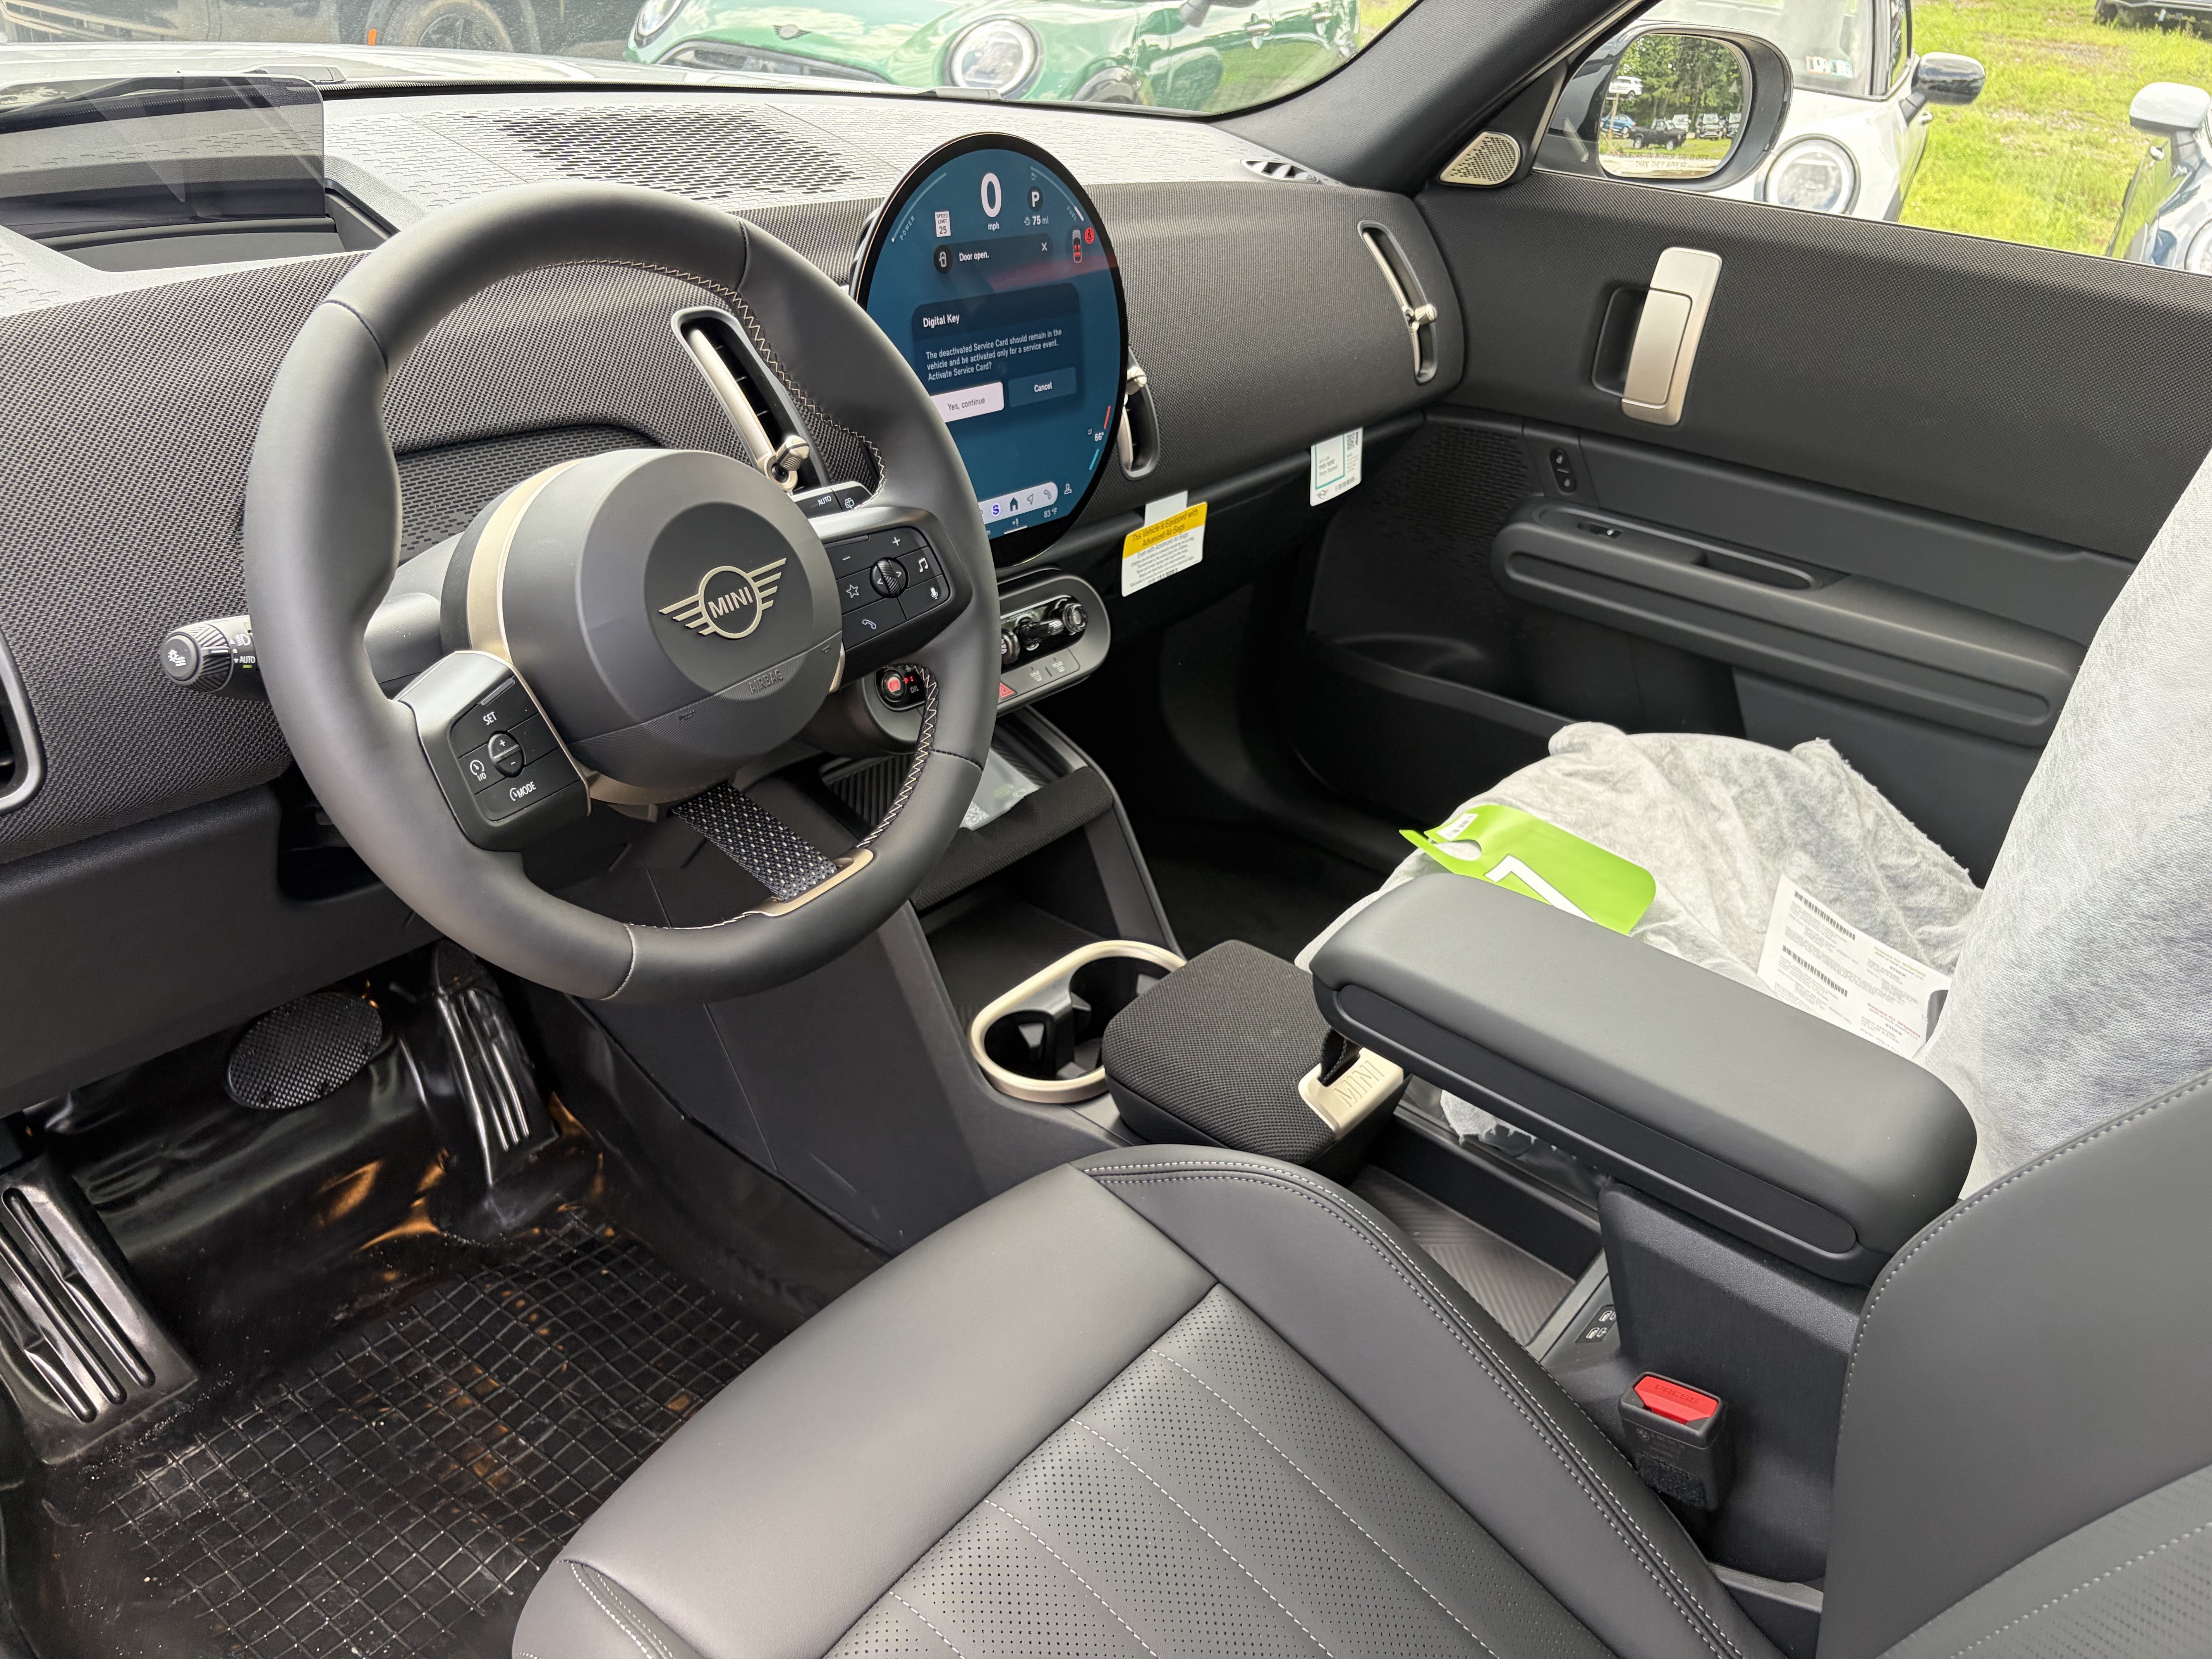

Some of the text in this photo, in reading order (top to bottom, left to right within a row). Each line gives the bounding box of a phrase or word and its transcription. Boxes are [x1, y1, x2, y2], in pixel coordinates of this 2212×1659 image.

[981, 172, 1002, 218] 0
[1031, 191, 1040, 207] P
[1032, 215, 1049, 225] 75 mi
[1066, 206, 1077, 222] FUEL
[900, 216, 915, 240] POWER
[939, 226, 947, 235] 25
[988, 222, 1000, 232] mph
[959, 251, 989, 262] Door open.
[923, 313, 960, 328] Digital Key
[926, 350, 938, 360] The
[939, 343, 972, 357] deactivated
[974, 341, 994, 352] Service
[995, 338, 1008, 348] Card
[1010, 335, 1027, 345] should
[1029, 332, 1046, 341] remain
[927, 360, 948, 371] vehicle
[949, 357, 960, 366] and
[962, 355, 969, 364] be
[970, 350, 996, 362] activated
[997, 348, 1008, 358] only
[1023, 342, 1042, 352] service
[1042, 338, 1059, 349] event.
[928, 362, 992, 381] Activate Service Card?
[1034, 381, 1053, 393] Cancel
[947, 397, 986, 411] Yes, continue
[817, 495, 832, 506] AUTO
[708, 586, 753, 619] MINI
[749, 669, 784, 694] AIRBAG
[483, 711, 497, 725] SET
[516, 781, 537, 799] MODE
[1331, 1060, 1385, 1108] MINI
[1654, 1384, 1700, 1404] PRESS
